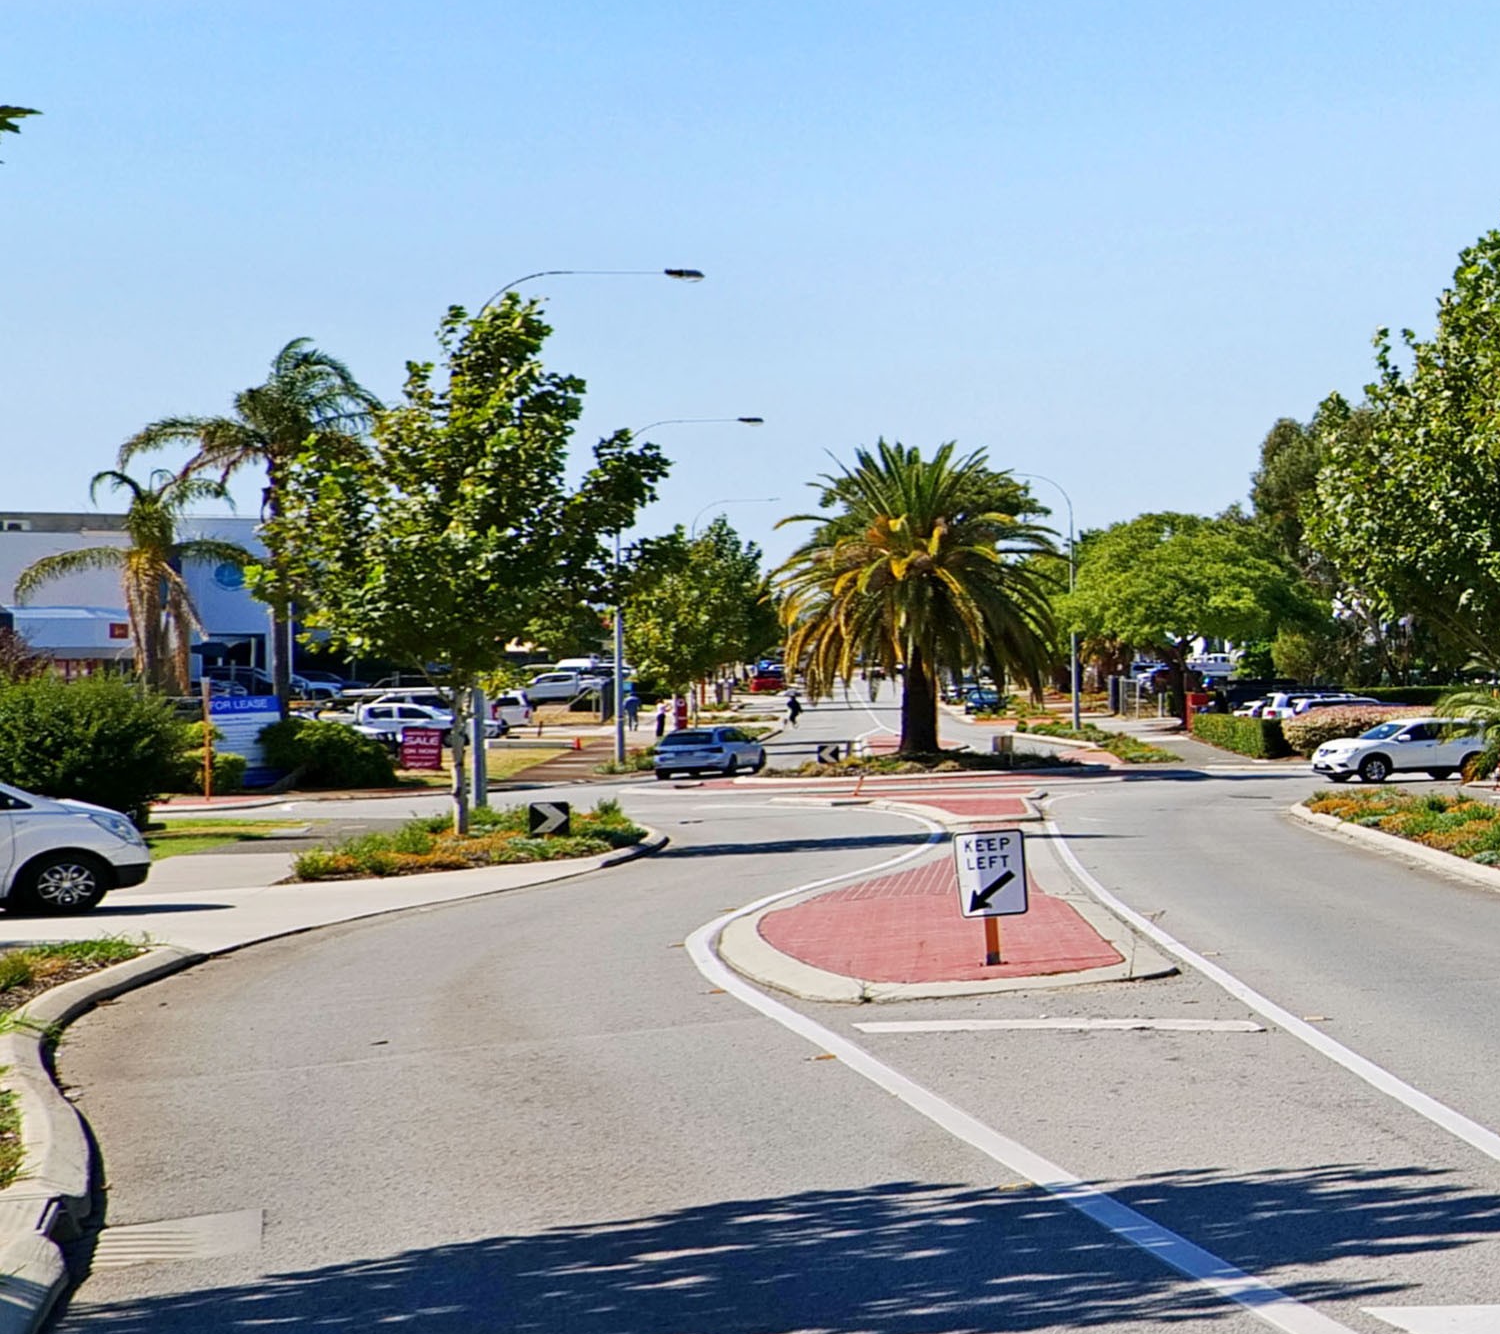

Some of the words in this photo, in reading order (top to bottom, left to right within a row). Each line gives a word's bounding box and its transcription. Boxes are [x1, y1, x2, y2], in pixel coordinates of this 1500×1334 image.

[234, 698, 268, 708] LEASE
[964, 837, 1010, 853] KEEP
[967, 855, 1009, 871] LEFT
